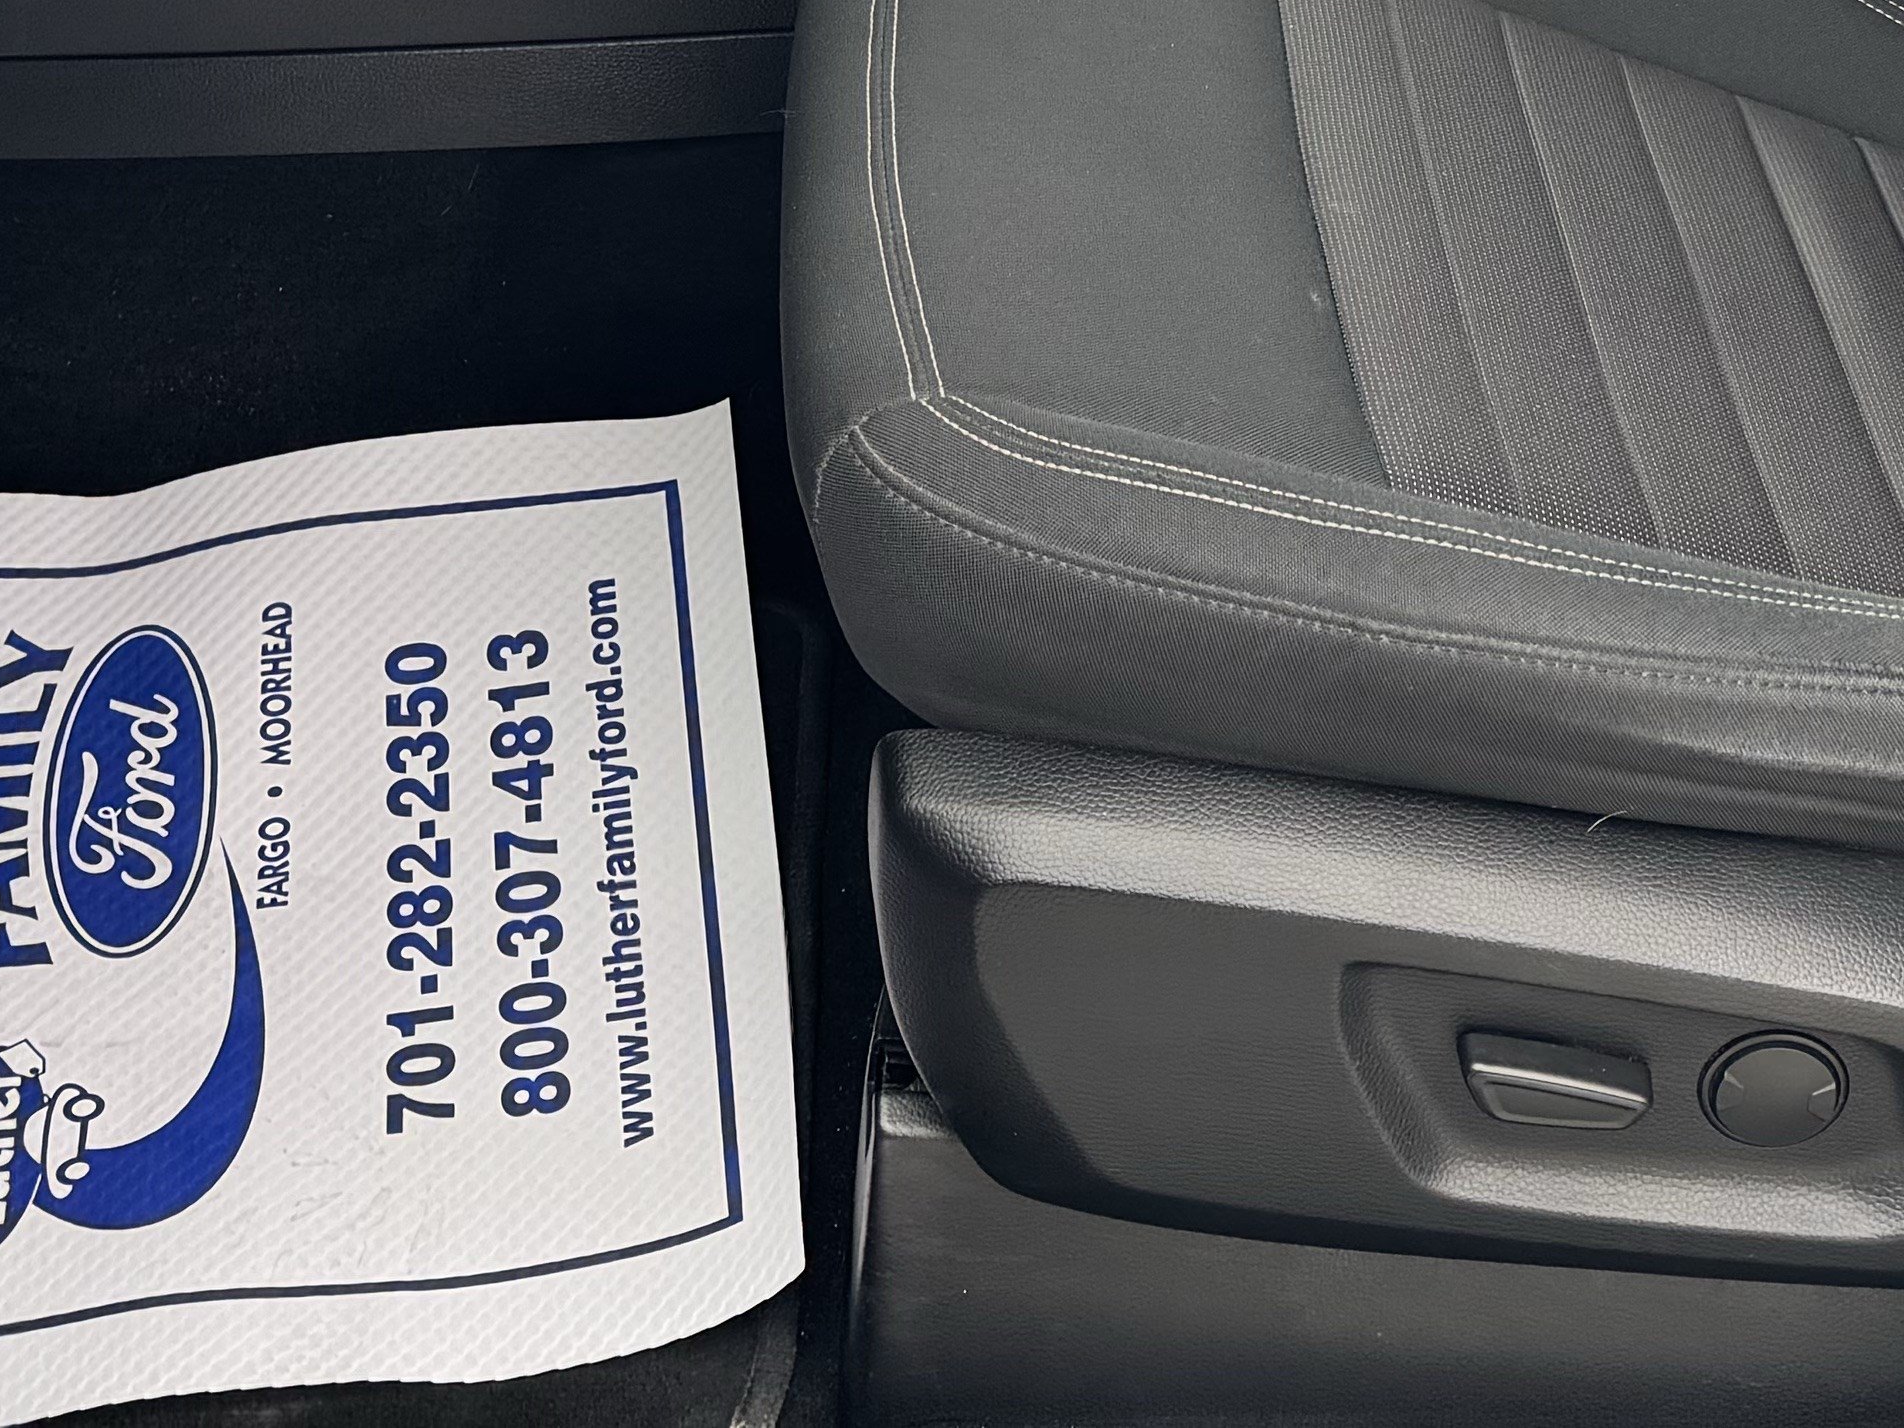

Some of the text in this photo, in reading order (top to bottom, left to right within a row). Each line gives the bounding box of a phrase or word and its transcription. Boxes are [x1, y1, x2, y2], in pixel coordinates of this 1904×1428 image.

[68, 693, 181, 890] Ford
[255, 600, 294, 911] FARGO MOORHEAD
[384, 639, 456, 1136] 701-282-2350
[486, 624, 566, 1119] 800-307-4813
[590, 577, 656, 1149] www.lutherfamilyford.com
